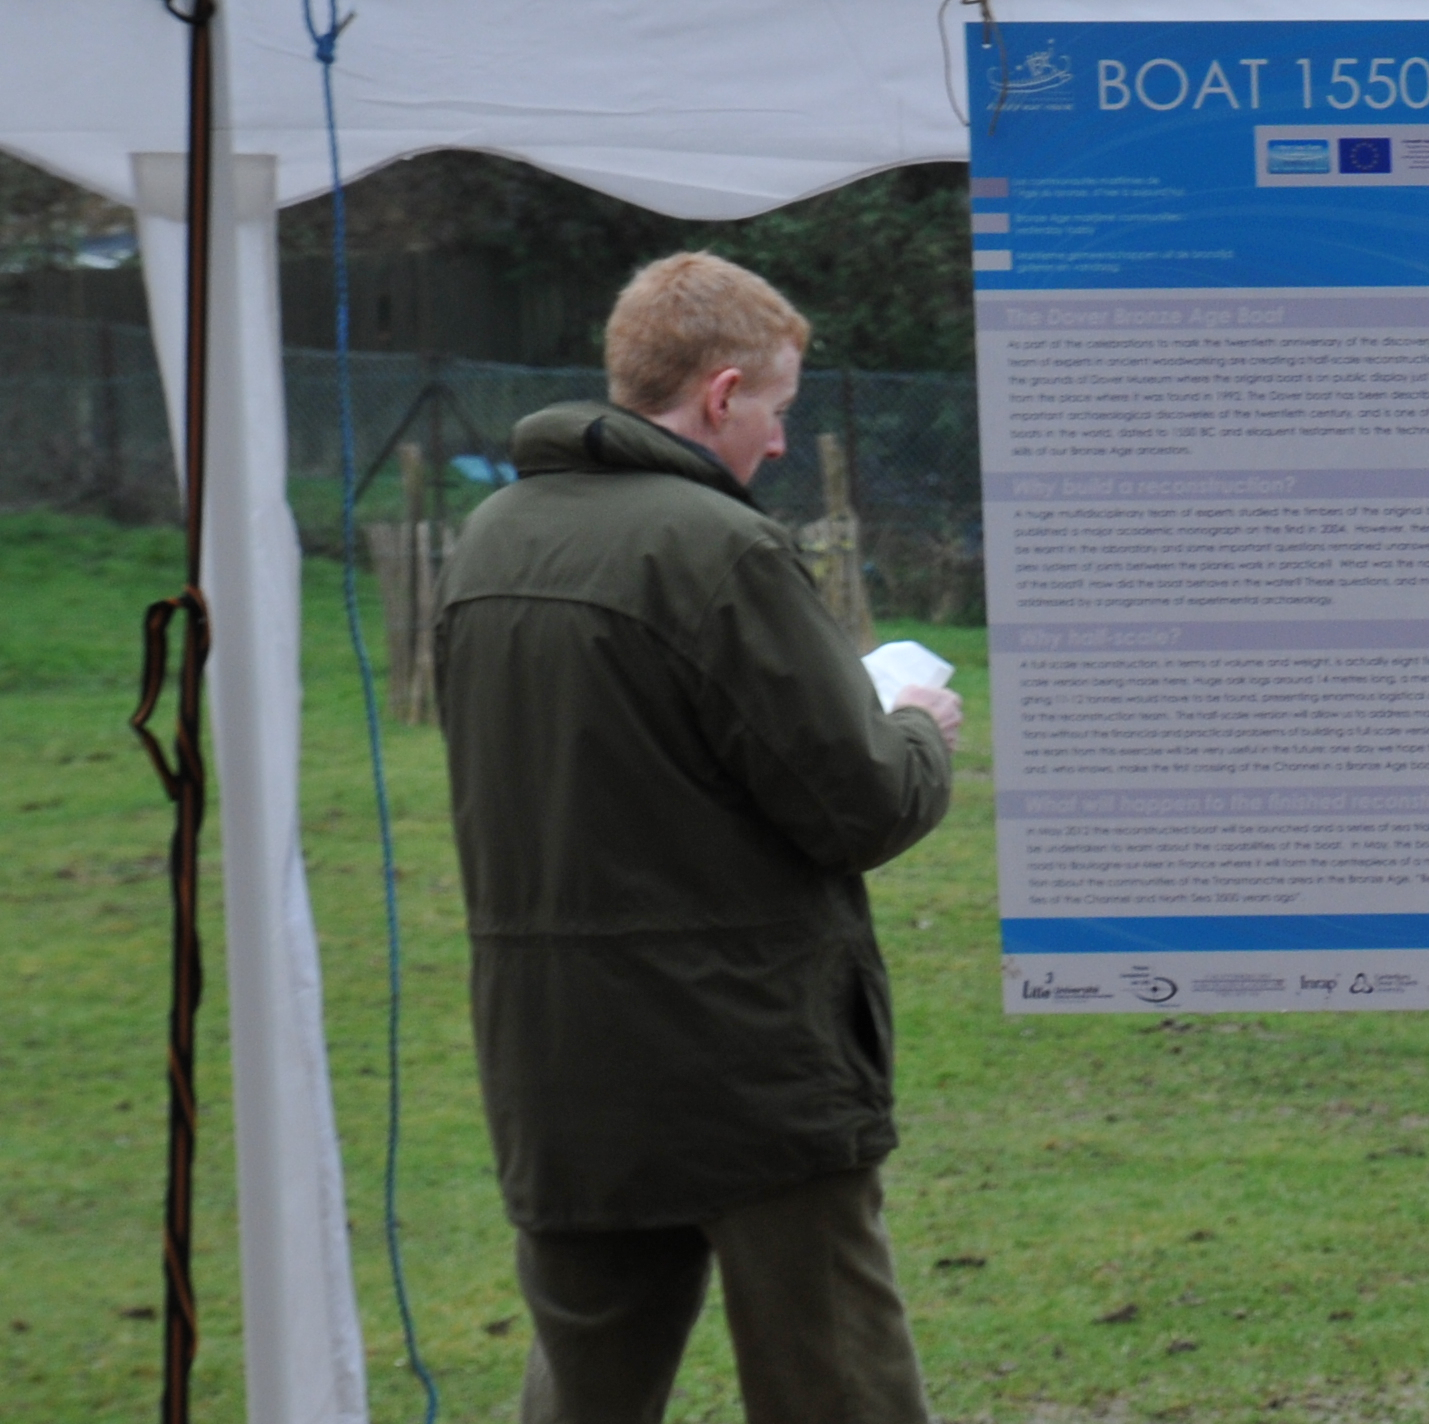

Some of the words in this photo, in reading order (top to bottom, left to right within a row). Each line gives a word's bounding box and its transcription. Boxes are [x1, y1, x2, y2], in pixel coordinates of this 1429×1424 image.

[1099, 57, 1268, 111] BOAT
[1006, 308, 1040, 326] The
[1047, 308, 1109, 325] Dover
[1113, 307, 1182, 325] Bronze
[1188, 307, 1232, 328] Age
[1237, 306, 1285, 324] Boat
[1012, 478, 1058, 499] Why
[1063, 478, 1114, 495] build
[1118, 481, 1134, 494] a
[1019, 629, 1063, 650] Why
[1025, 796, 1078, 813] What
[1081, 796, 1116, 812] will
[1205, 795, 1224, 811] to
[1230, 794, 1263, 811] the
